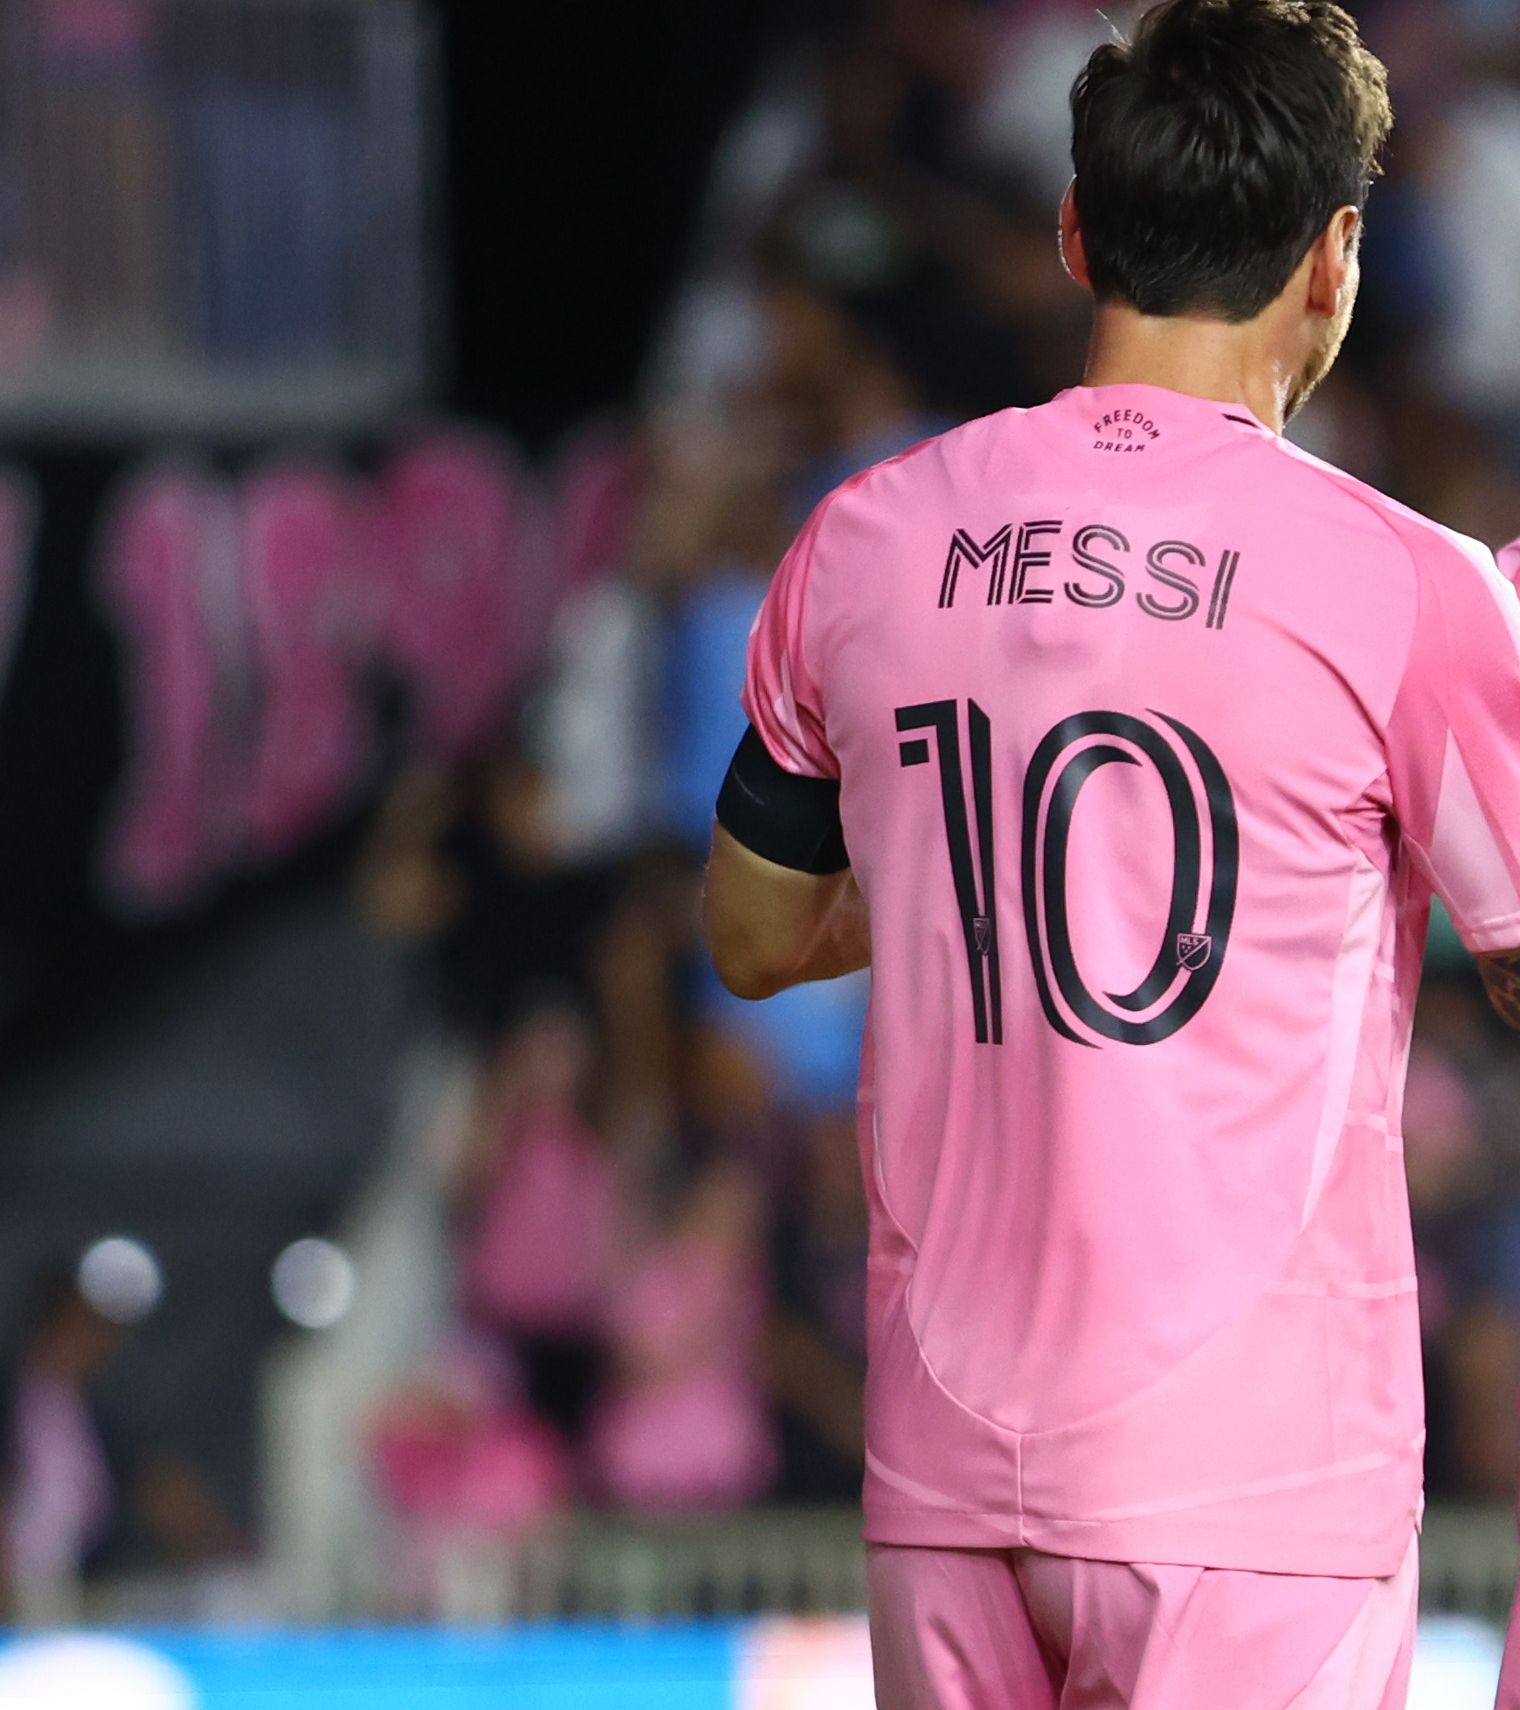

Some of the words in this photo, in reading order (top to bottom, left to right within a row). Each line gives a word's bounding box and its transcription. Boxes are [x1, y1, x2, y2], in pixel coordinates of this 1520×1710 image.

[1094, 409, 1160, 440] FREEDOM
[1117, 427, 1132, 439] TO
[1093, 440, 1146, 452] DREAM
[938, 520, 1241, 630] MESSI
[895, 698, 1240, 1049] 10
